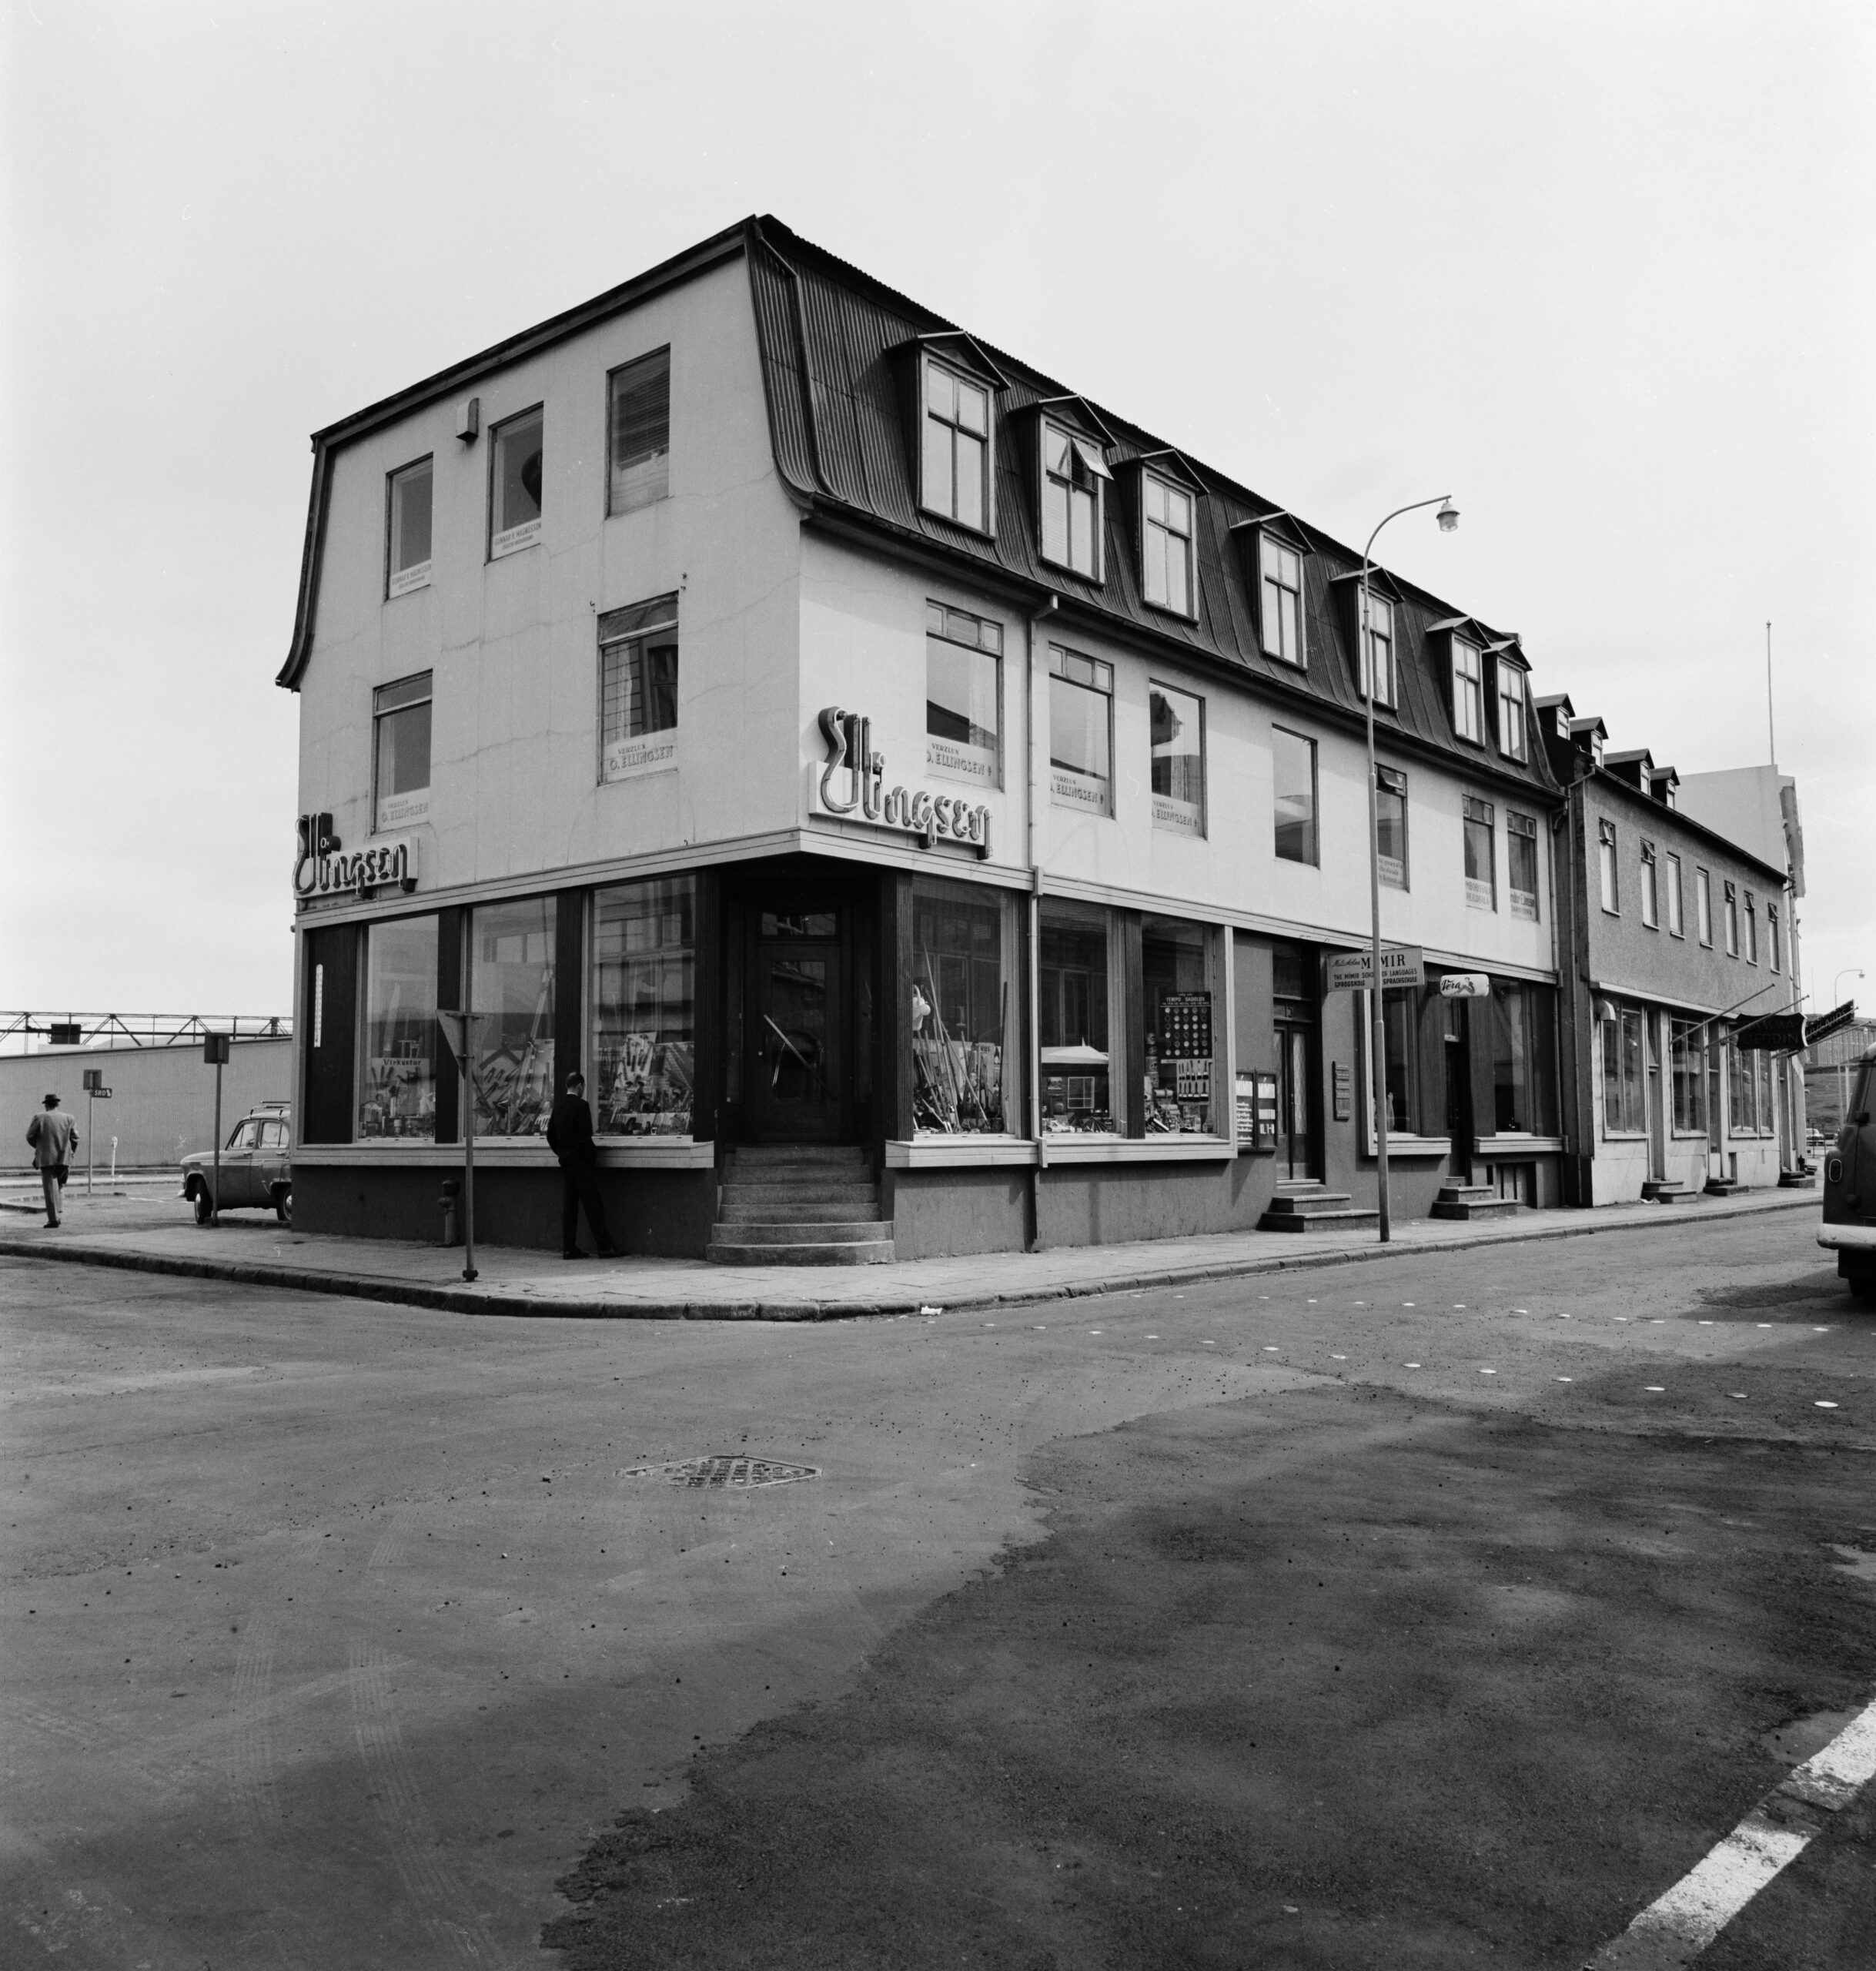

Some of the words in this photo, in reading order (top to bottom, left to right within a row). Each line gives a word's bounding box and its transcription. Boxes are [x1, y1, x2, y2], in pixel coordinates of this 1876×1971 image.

[621, 745, 674, 768] ELLINGSEN
[935, 751, 985, 775] ELLINGSEN
[1056, 783, 1098, 803] ELLINGSEN
[390, 801, 429, 821] ELLINGSEN
[1156, 809, 1192, 826] ELLINGSEN
[1361, 954, 1406, 969] MMIR
[1383, 976, 1417, 985] SPRACHSCHULE
[1389, 968, 1417, 977] LANGUAGES
